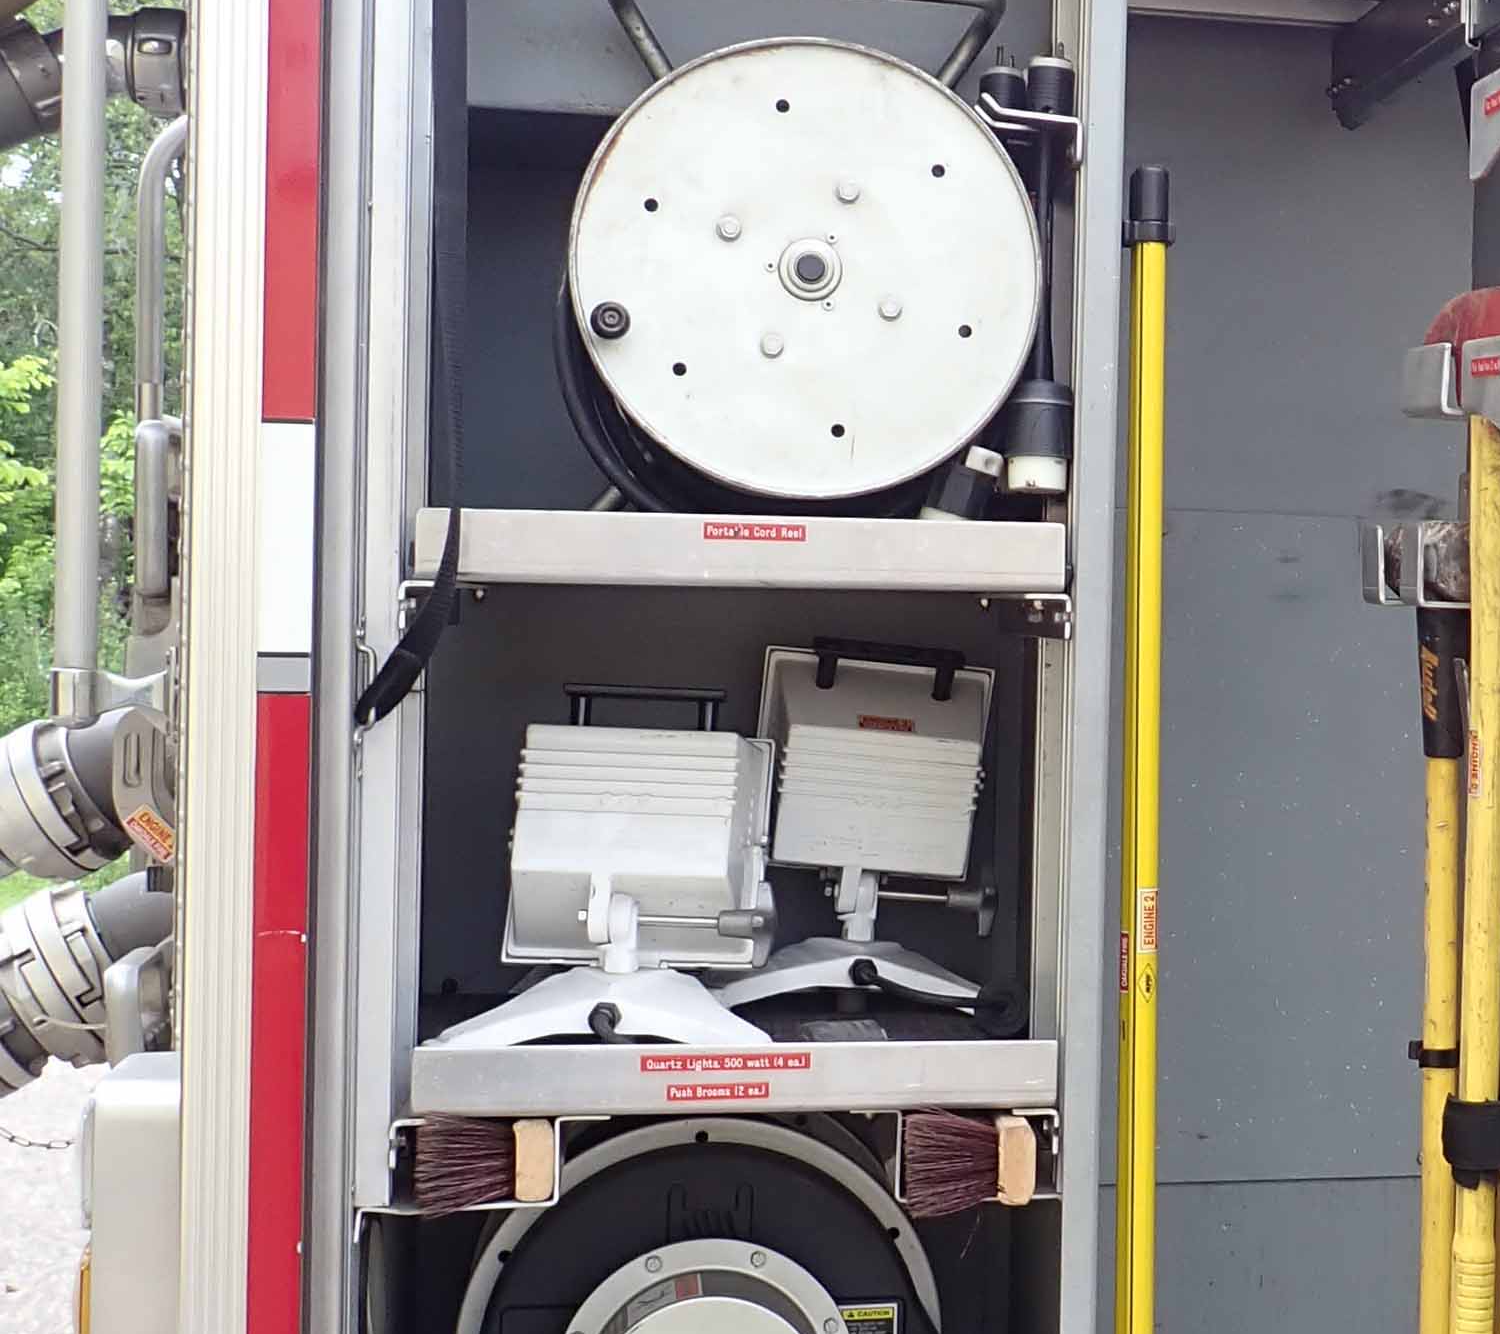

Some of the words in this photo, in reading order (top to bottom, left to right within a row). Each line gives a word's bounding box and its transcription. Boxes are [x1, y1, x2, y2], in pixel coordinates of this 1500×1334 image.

[753, 526, 777, 538] Cord
[781, 527, 803, 539] Reel
[1144, 894, 1155, 903] 2
[1143, 905, 1155, 946] ENGINE
[646, 1059, 683, 1069] Quartz
[724, 1058, 743, 1067] 500
[747, 1058, 770, 1067] watt
[670, 1086, 692, 1098] Push
[696, 1085, 730, 1097] Brooms
